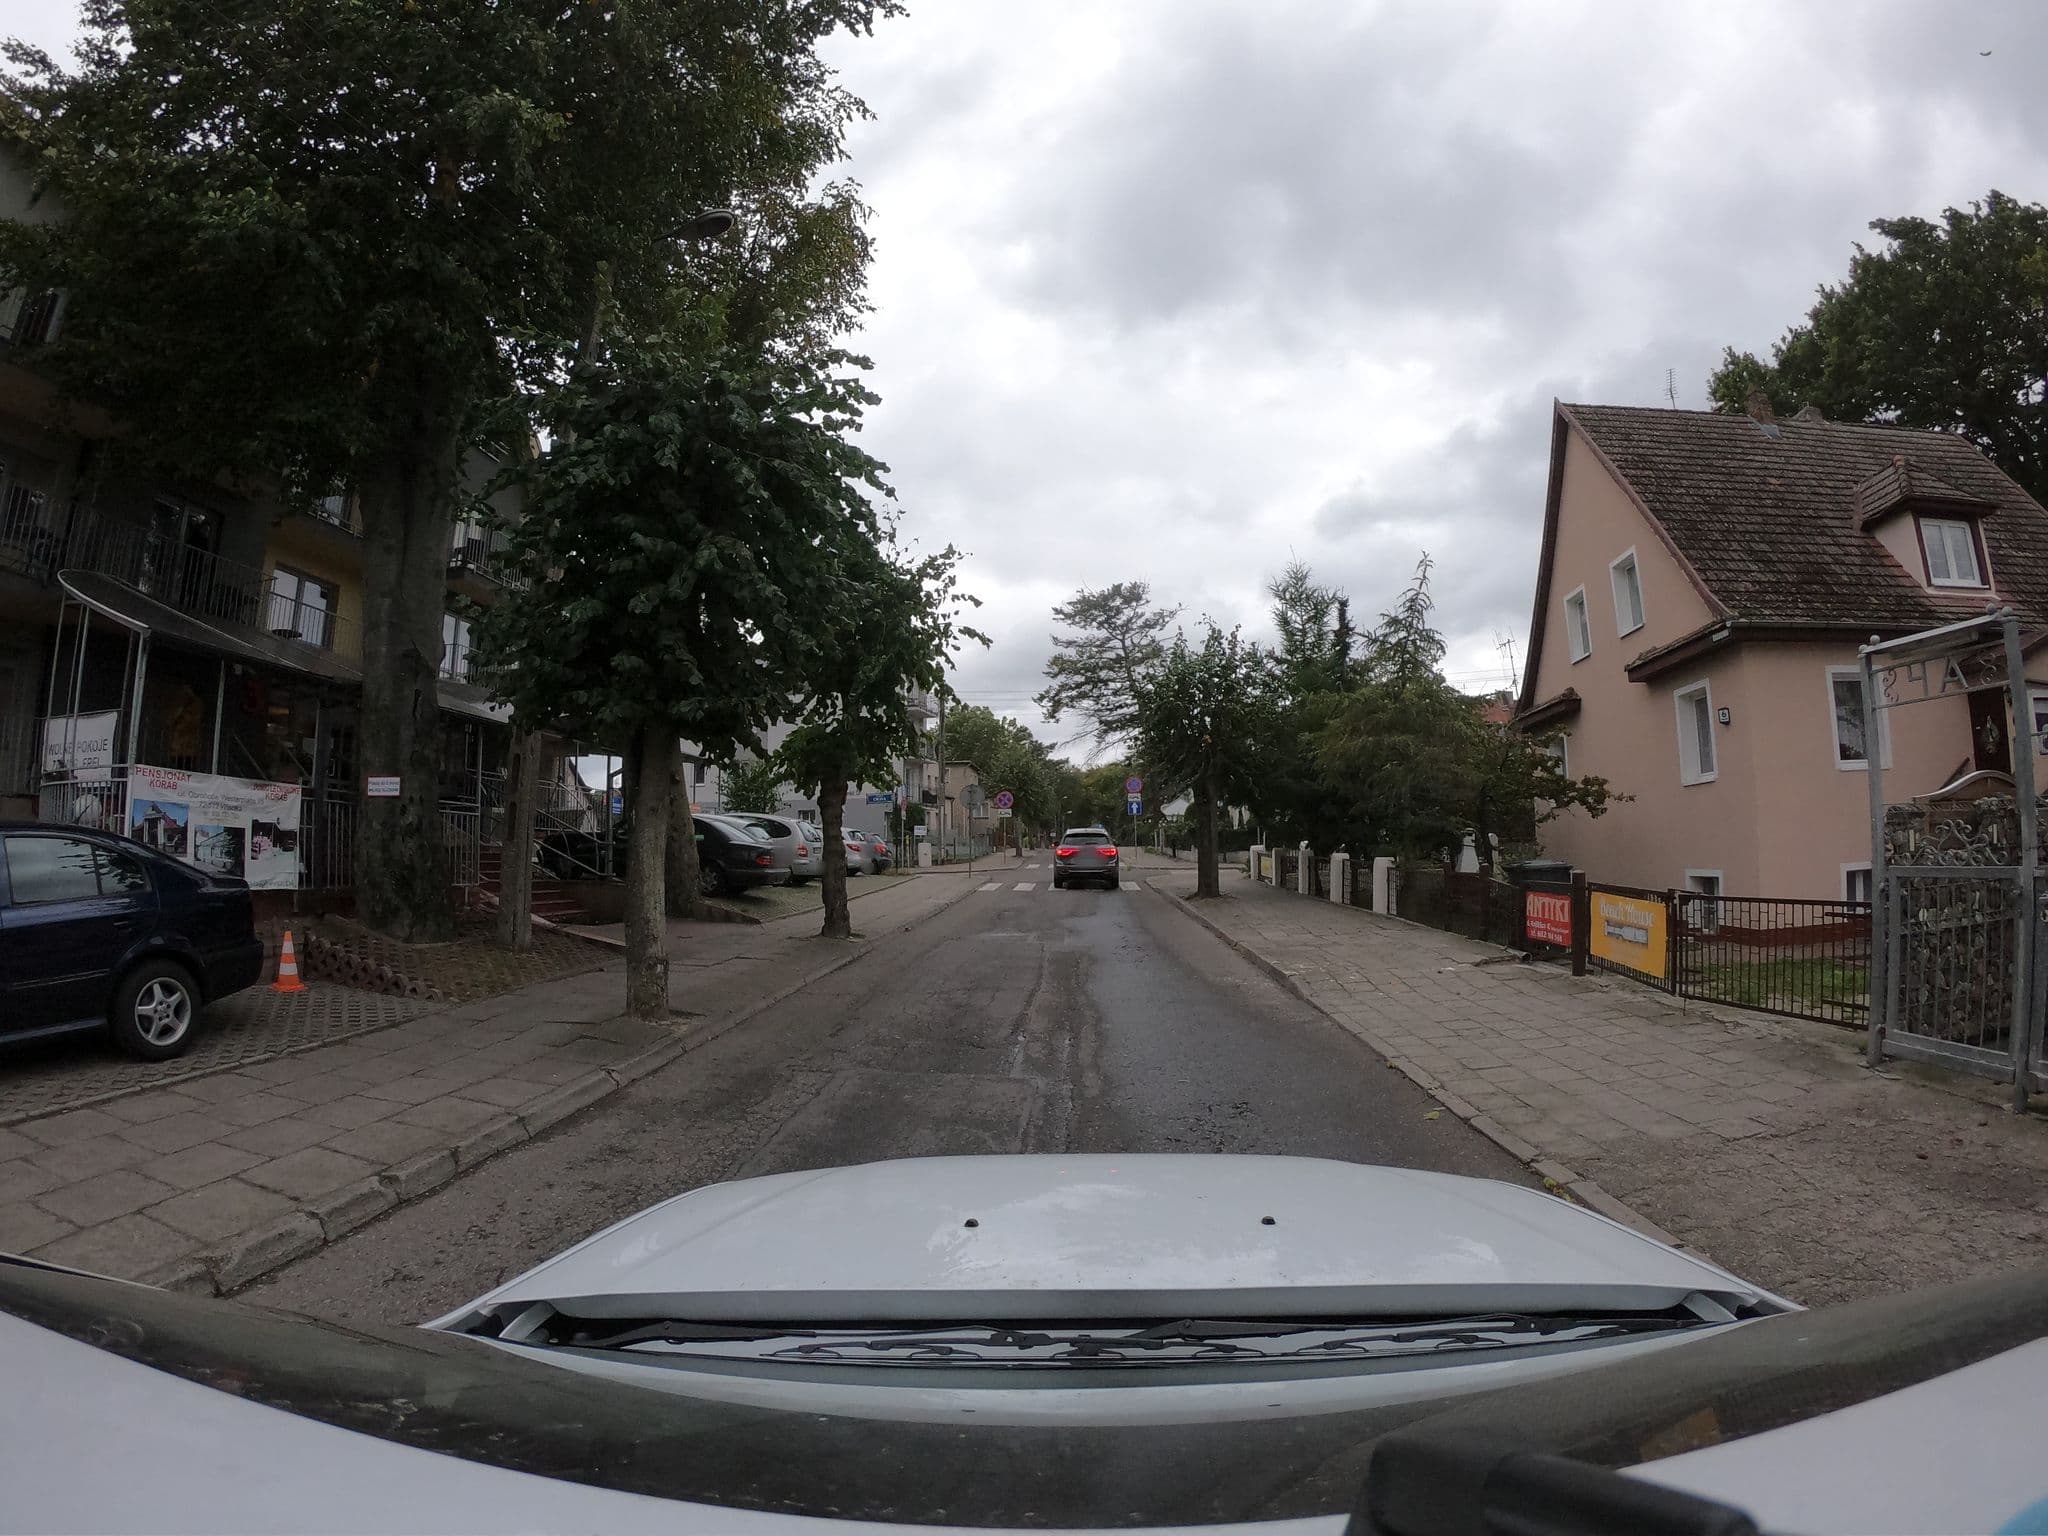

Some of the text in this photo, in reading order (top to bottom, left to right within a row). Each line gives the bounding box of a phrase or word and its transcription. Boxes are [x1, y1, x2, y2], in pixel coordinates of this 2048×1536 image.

[135, 766, 192, 783] PENSJONAT
[149, 779, 177, 790] KORAB
[1526, 894, 1569, 922] ANTYKI
